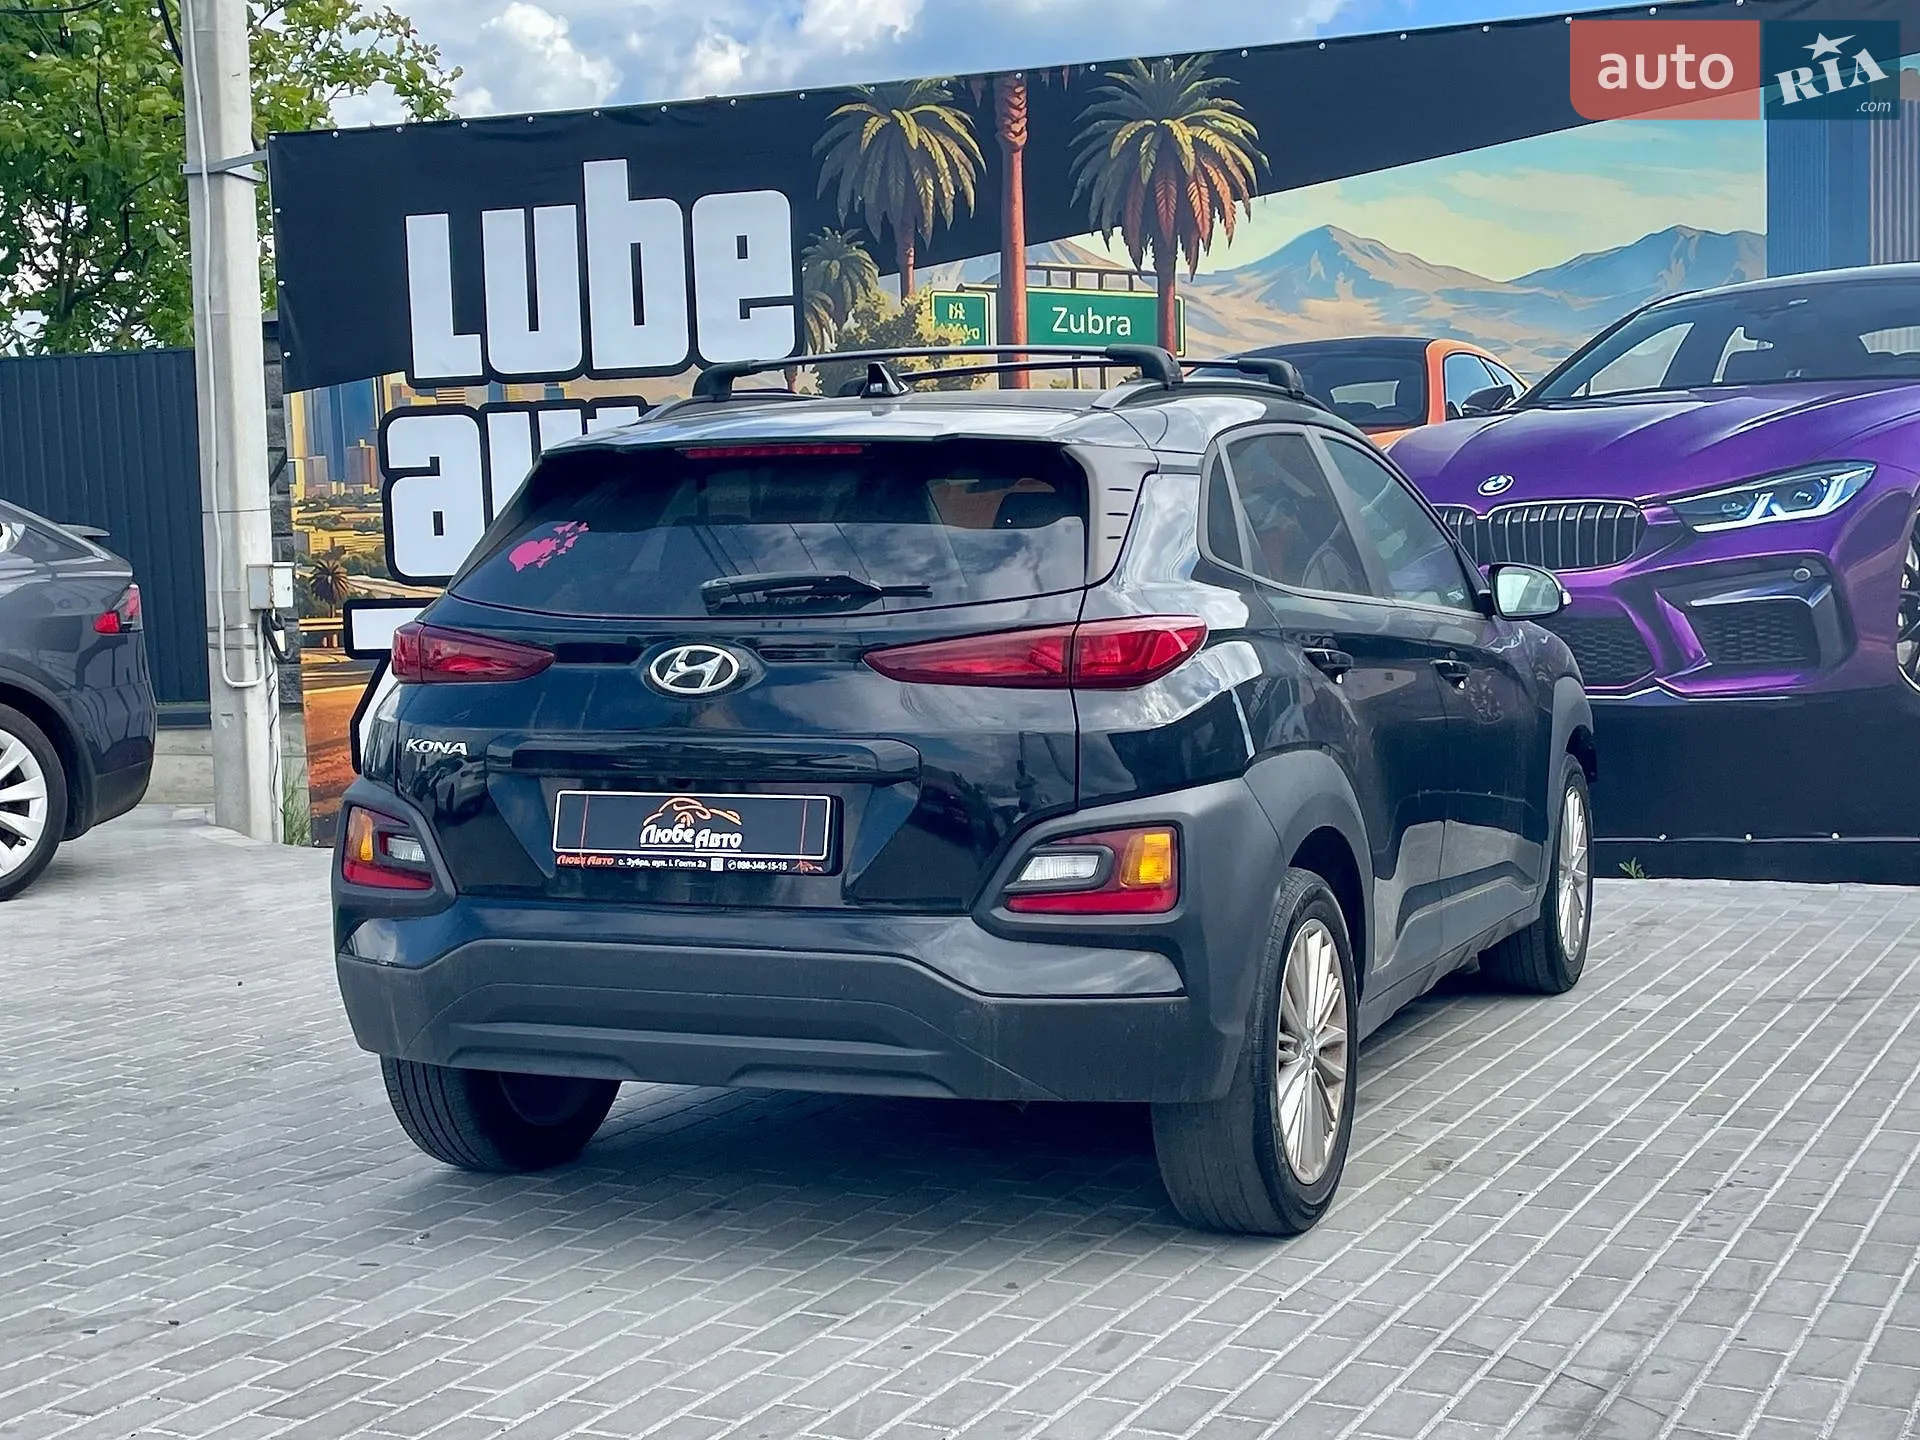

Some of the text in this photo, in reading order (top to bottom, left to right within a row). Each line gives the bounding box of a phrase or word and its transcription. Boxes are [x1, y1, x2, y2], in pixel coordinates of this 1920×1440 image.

[404, 158, 798, 380] Lube
[1051, 306, 1132, 337] Zubra
[405, 738, 468, 756] KONA
[694, 828, 743, 849] Авто
